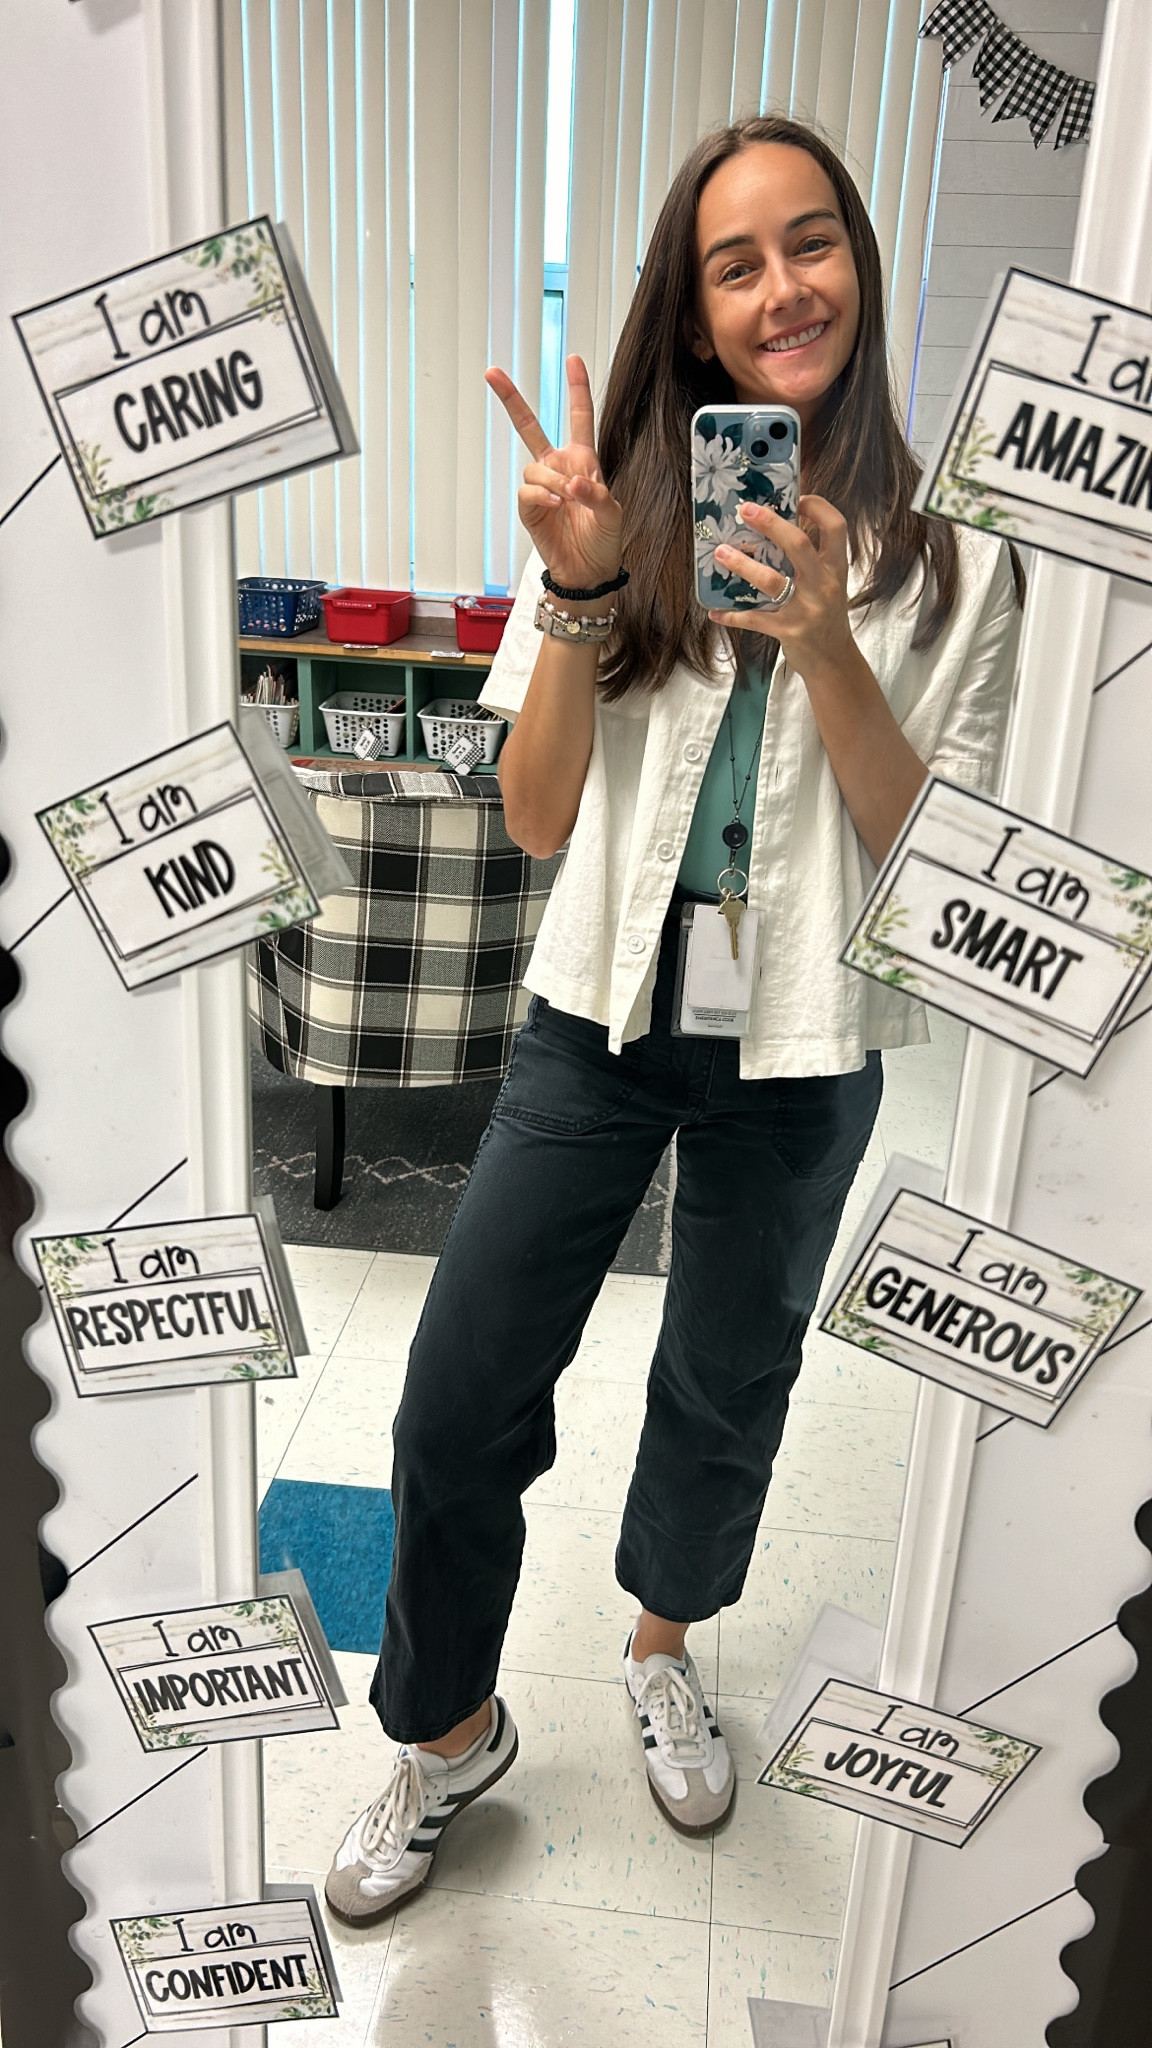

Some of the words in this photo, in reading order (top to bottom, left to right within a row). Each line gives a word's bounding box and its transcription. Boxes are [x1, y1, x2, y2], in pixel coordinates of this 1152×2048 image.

[95, 293, 130, 359] I
[139, 288, 211, 347] am
[1071, 313, 1112, 385] I
[1109, 356, 1152, 404] a
[114, 350, 264, 453] CARING
[100, 791, 135, 845] I
[138, 784, 198, 833] am
[143, 839, 236, 919] KIND
[981, 826, 1022, 882] I
[1015, 867, 1090, 921] am
[931, 898, 1084, 1001] SMART
[102, 1237, 129, 1284] I
[139, 1245, 201, 1279] am
[946, 1228, 984, 1273] I
[979, 1261, 1048, 1306] am
[65, 1287, 273, 1350] RESPECTFUL
[865, 1265, 1076, 1385] GENEROUS
[152, 1619, 180, 1657] I
[187, 1625, 243, 1653] am
[132, 1657, 309, 1714] IMPORTANT
[870, 1704, 903, 1736] I
[899, 1726, 960, 1758] am
[823, 1742, 953, 1808] JOYFUL
[172, 1917, 195, 1952] I
[204, 1922, 257, 1949] am
[145, 1953, 310, 2003] CONFIDENT
